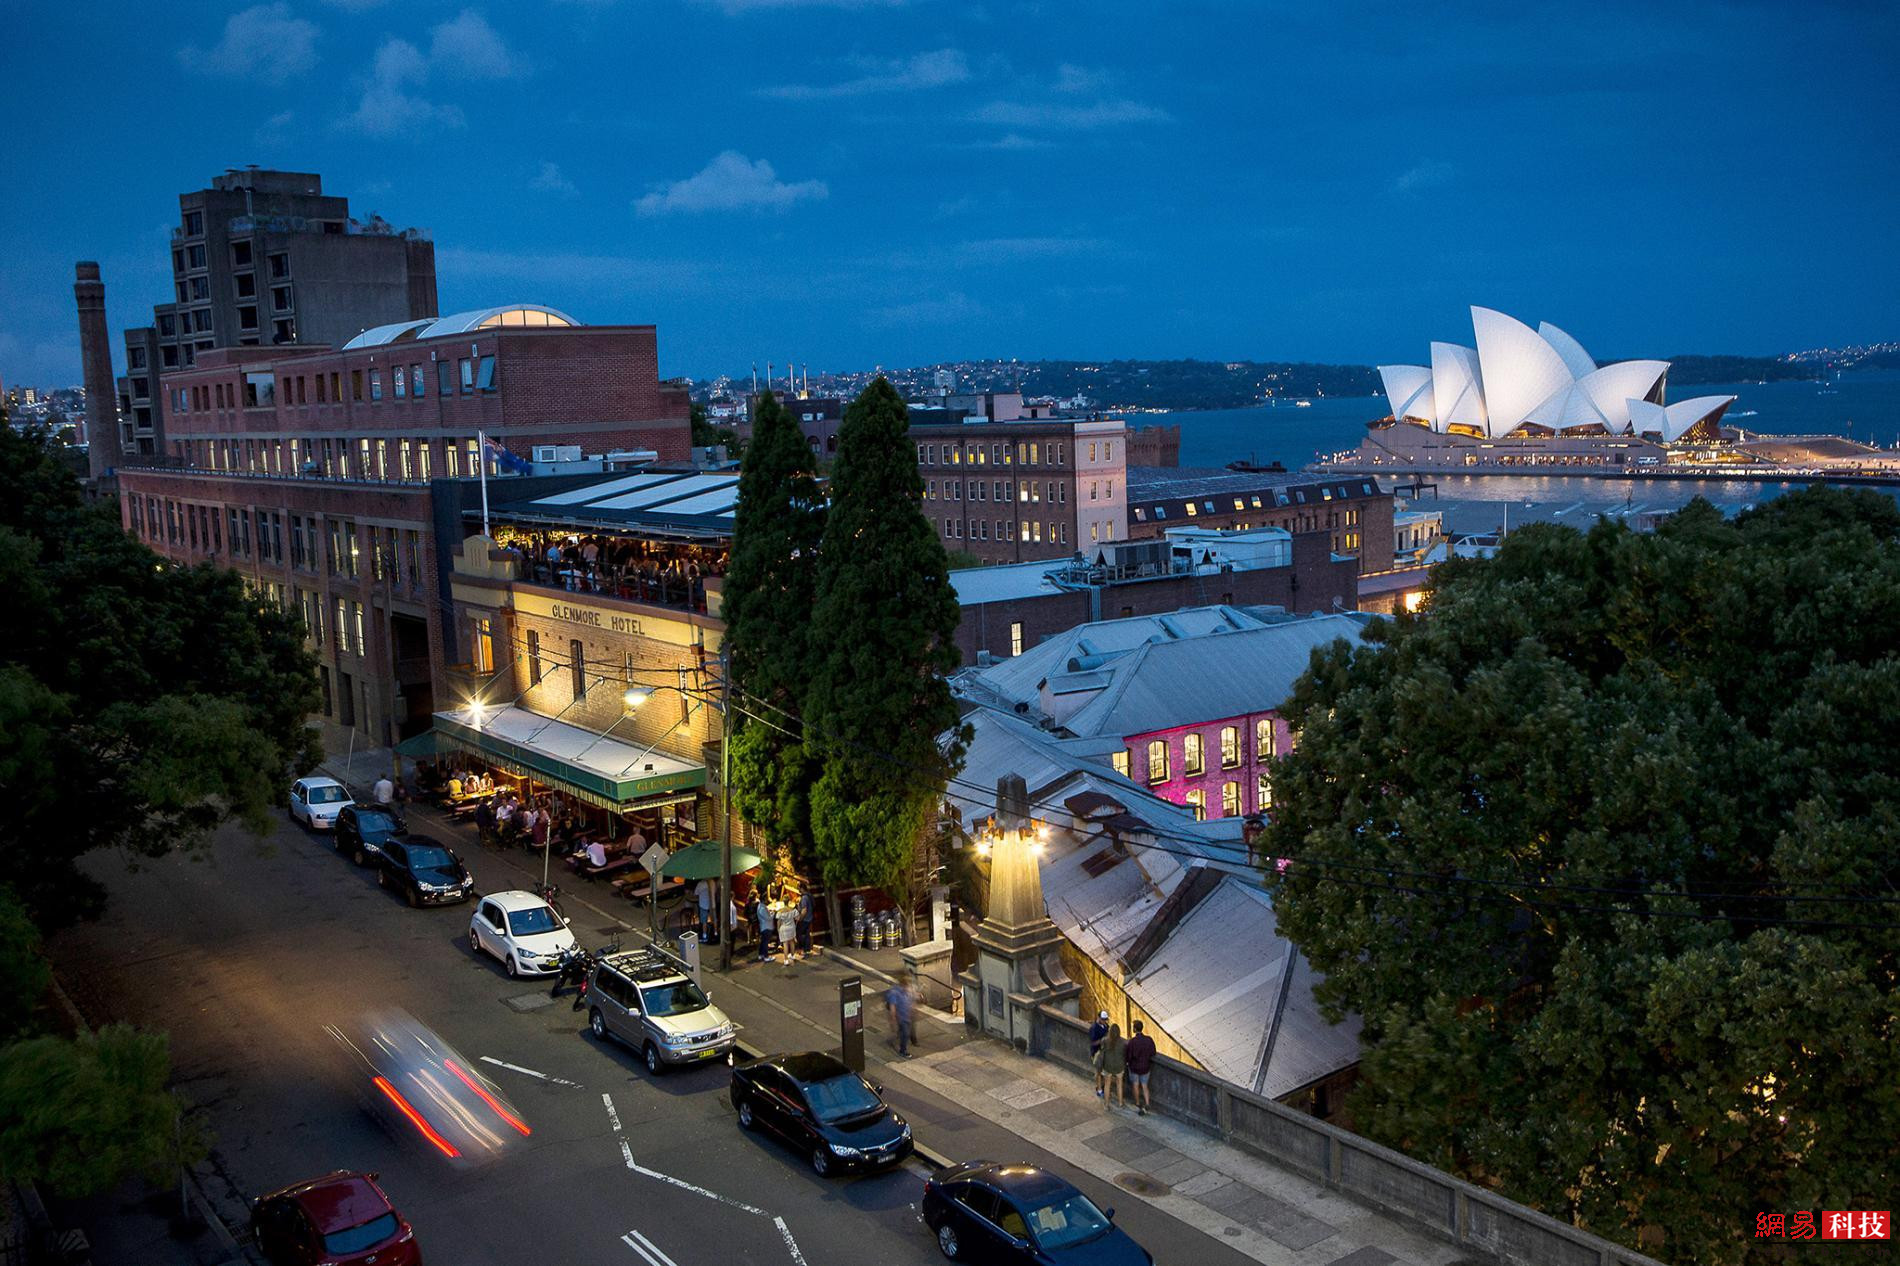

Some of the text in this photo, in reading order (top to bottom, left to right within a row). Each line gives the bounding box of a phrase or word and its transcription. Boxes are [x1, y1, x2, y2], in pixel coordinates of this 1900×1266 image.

[552, 604, 645, 635] GLENMORE HOTEL
[636, 775, 695, 791] GLENM
